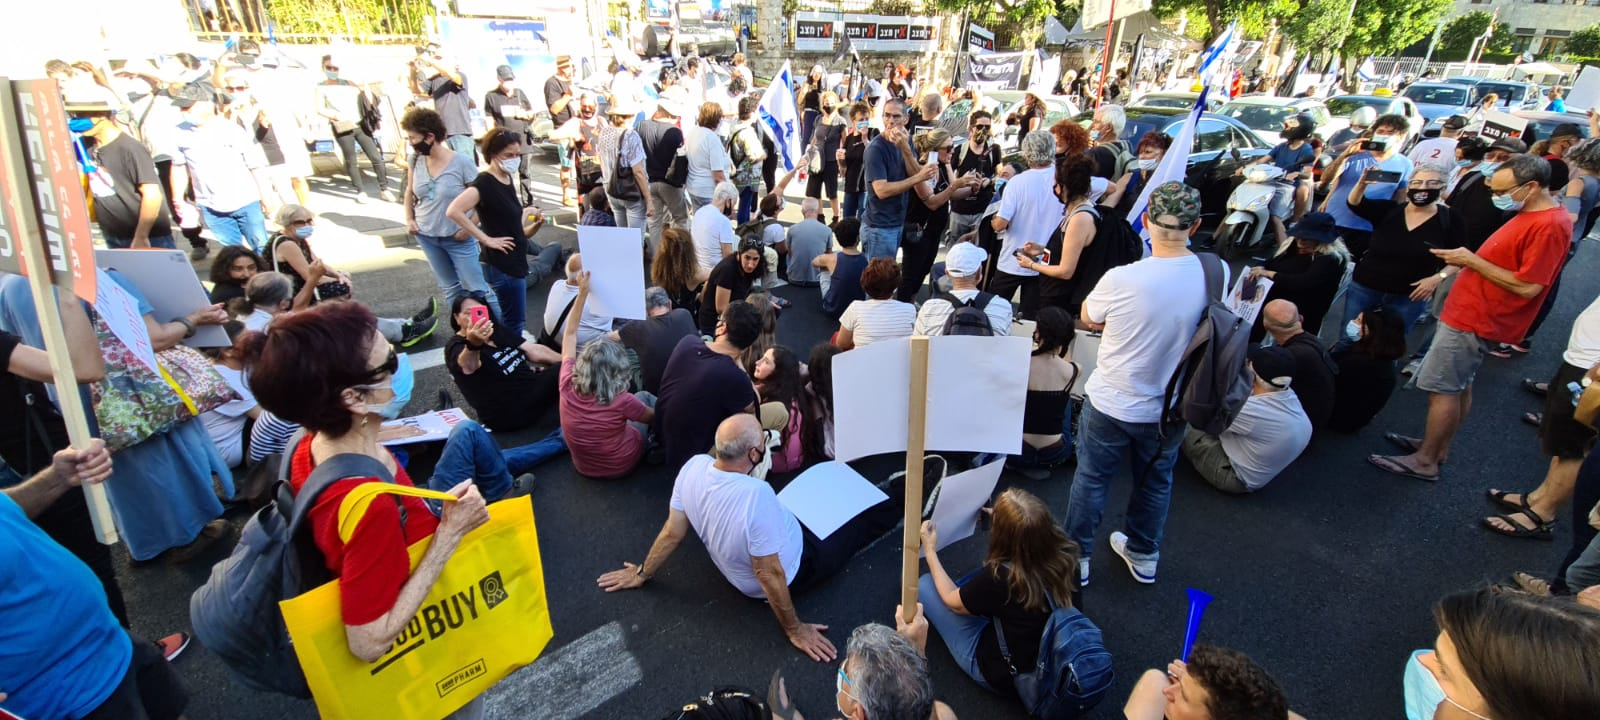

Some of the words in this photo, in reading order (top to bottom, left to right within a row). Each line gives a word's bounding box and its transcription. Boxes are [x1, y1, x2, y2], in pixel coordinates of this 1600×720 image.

[799, 25, 815, 35] מצב
[846, 27, 861, 36] מצב
[879, 28, 893, 37] מצב
[1430, 149, 1441, 158] 2
[19, 92, 68, 272] הכיבוש
[422, 585, 478, 641] BUY
[454, 664, 482, 684] PHARM
